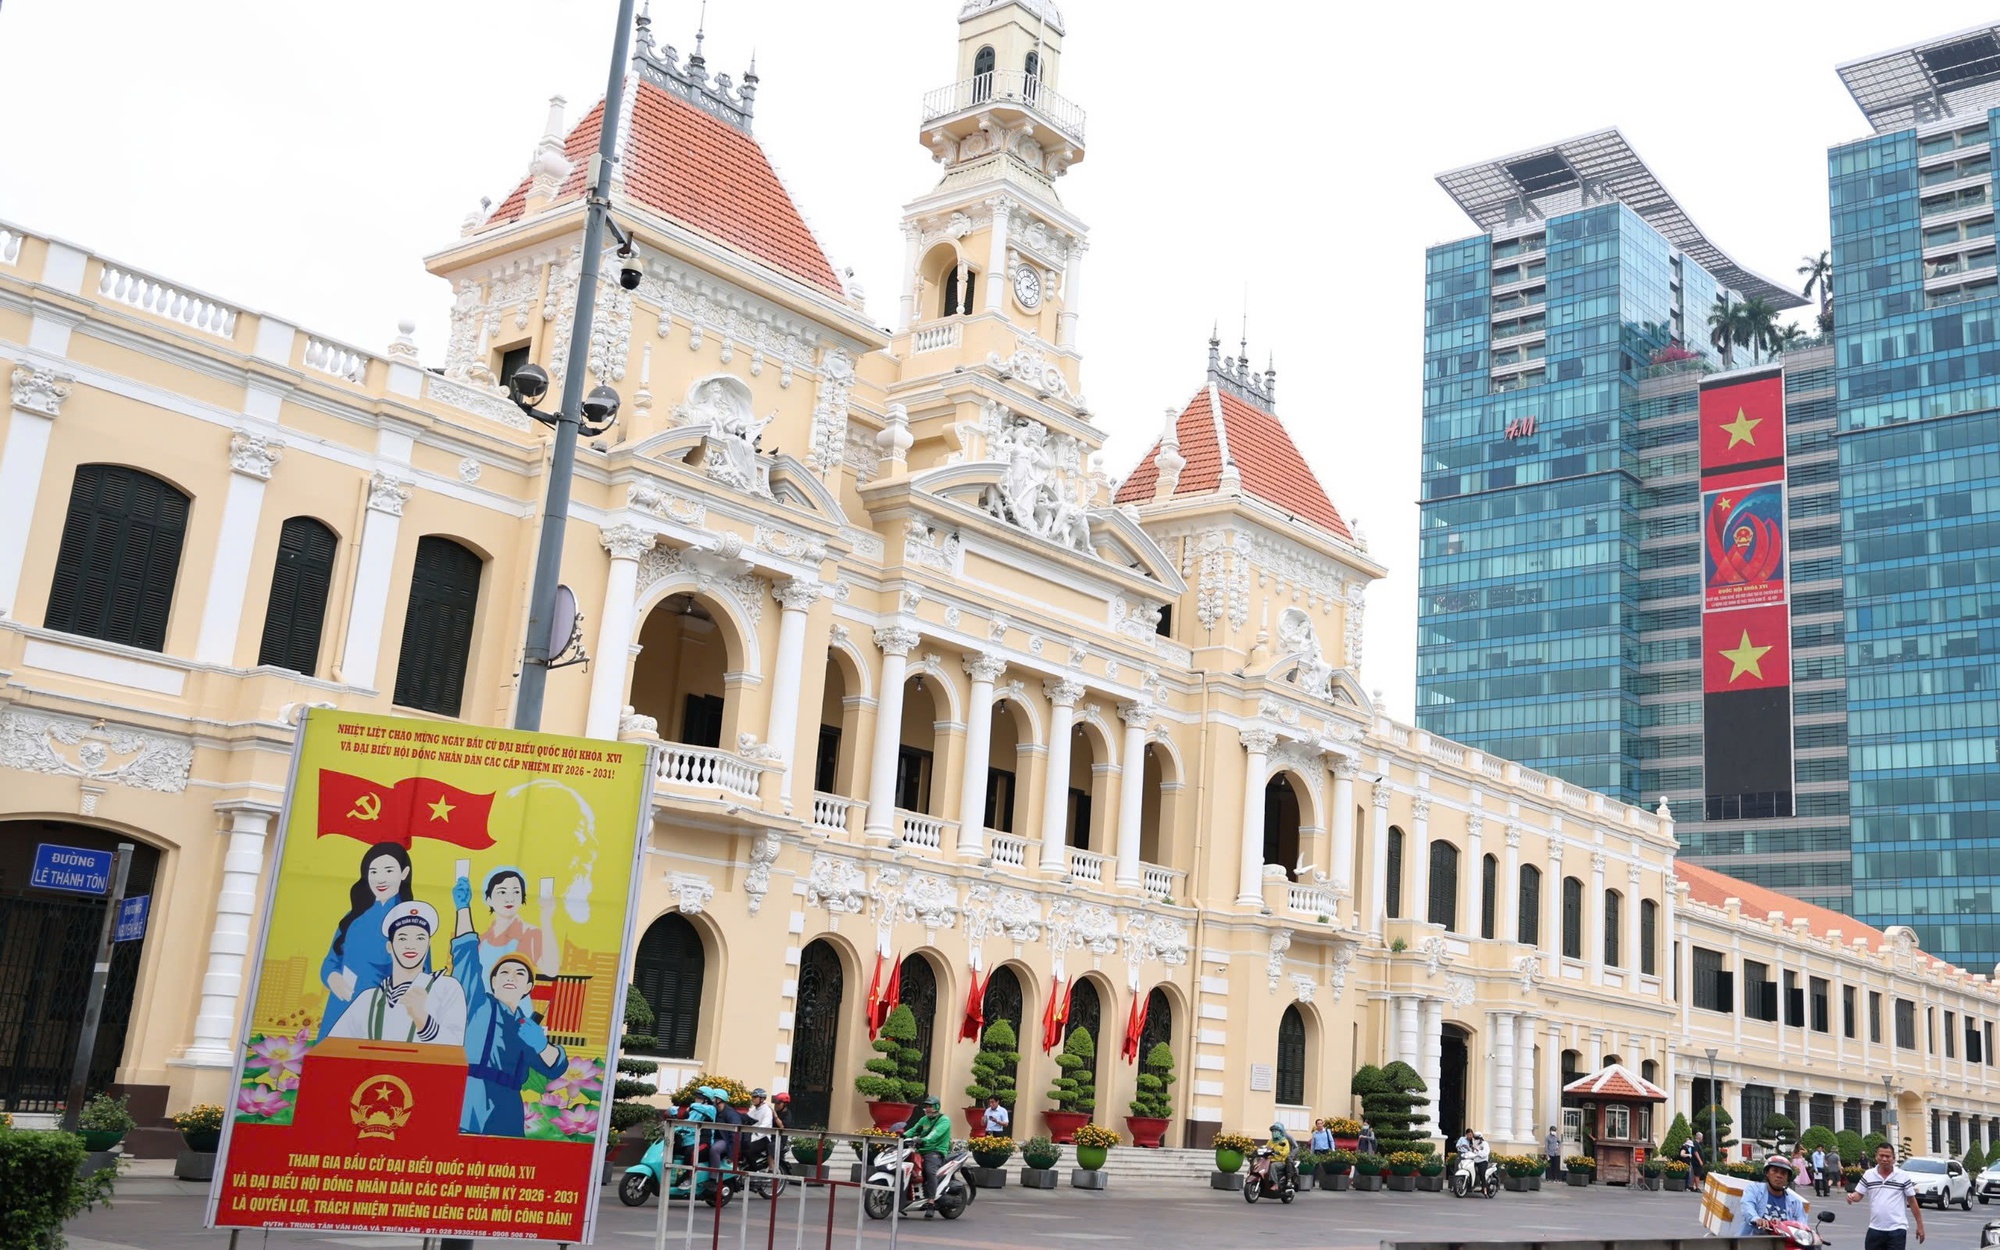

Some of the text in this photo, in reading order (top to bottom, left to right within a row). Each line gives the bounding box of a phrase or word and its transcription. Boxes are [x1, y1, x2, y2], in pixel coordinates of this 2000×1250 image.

[1505, 415, 1535, 441] H&M
[338, 723, 622, 764] NHIỆT LIỆT CHÀO MỪNG NGÀY BẦU CỬ ĐẠI BIỂU QUỐC HỘI KHÓA XVI
[340, 740, 351, 751] VÀ
[353, 743, 369, 755] ĐẠI
[371, 741, 392, 755] BIỂU
[393, 745, 410, 759] HỘI
[411, 746, 436, 760] ĐỒNG
[438, 750, 462, 764] NHÂN
[464, 753, 482, 766] DÂN
[484, 754, 501, 767] CÁC
[503, 757, 520, 770] CẤP
[521, 760, 550, 774] NHIỆM
[552, 762, 564, 774] KỲ
[565, 765, 585, 777] 2026
[593, 767, 615, 779] 2031!
[52, 851, 95, 868] ĐƯỜNG
[34, 867, 106, 890] LÊ THÁNH TÔN
[288, 1152, 536, 1180] THAM GIA BẦU CỬ ĐẠI BIỂU QUỐC HỘI KHÓA XVI
[232, 1171, 247, 1188] VÀ
[250, 1174, 271, 1191] ĐẠI
[271, 1170, 299, 1190] BIỂU
[301, 1174, 321, 1193] HỘI
[322, 1173, 354, 1193] ĐỒNG
[356, 1177, 388, 1194] NHÂN
[390, 1179, 413, 1195] DÂN
[415, 1180, 438, 1196] CÁC
[440, 1180, 462, 1198] CẤP
[464, 1183, 500, 1202] NHIỆM
[502, 1184, 517, 1201] KỲ
[518, 1188, 545, 1202] 2026
[553, 1190, 579, 1204] 2031
[232, 1194, 573, 1226] LÀ QUYỀN LỢI, TRÁCH NHIỆM THIÊNG LIÊNG CỦA MỖI CÔNG DÂN!
